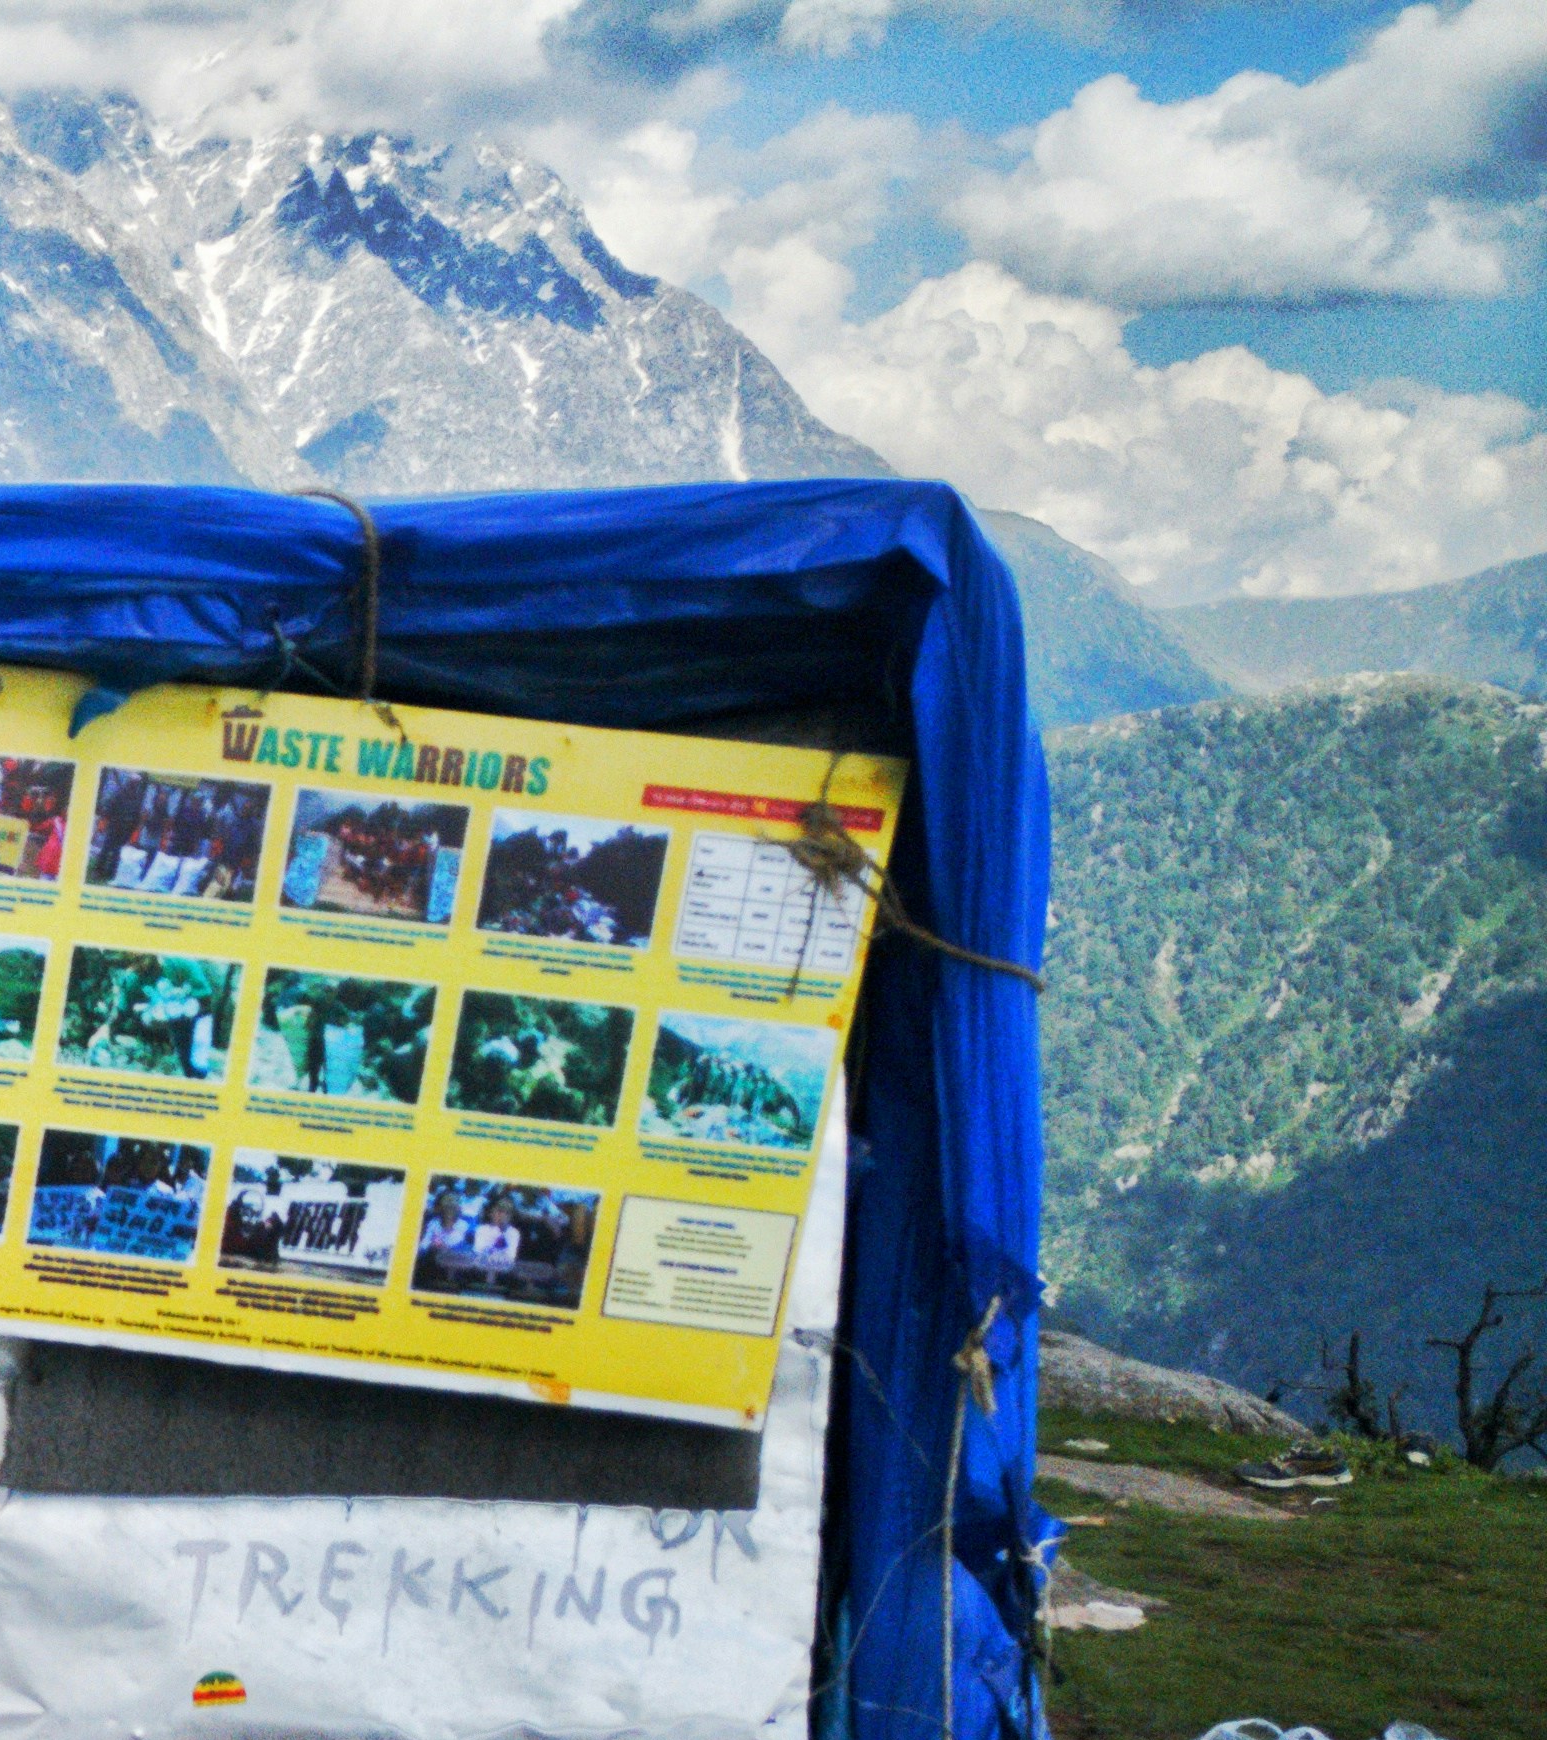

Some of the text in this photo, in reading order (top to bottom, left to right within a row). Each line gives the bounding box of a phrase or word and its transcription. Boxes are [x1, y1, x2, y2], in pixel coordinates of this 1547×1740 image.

[222, 708, 551, 797] WASTE WARRIORS
[174, 1539, 682, 1648] TREKKING
